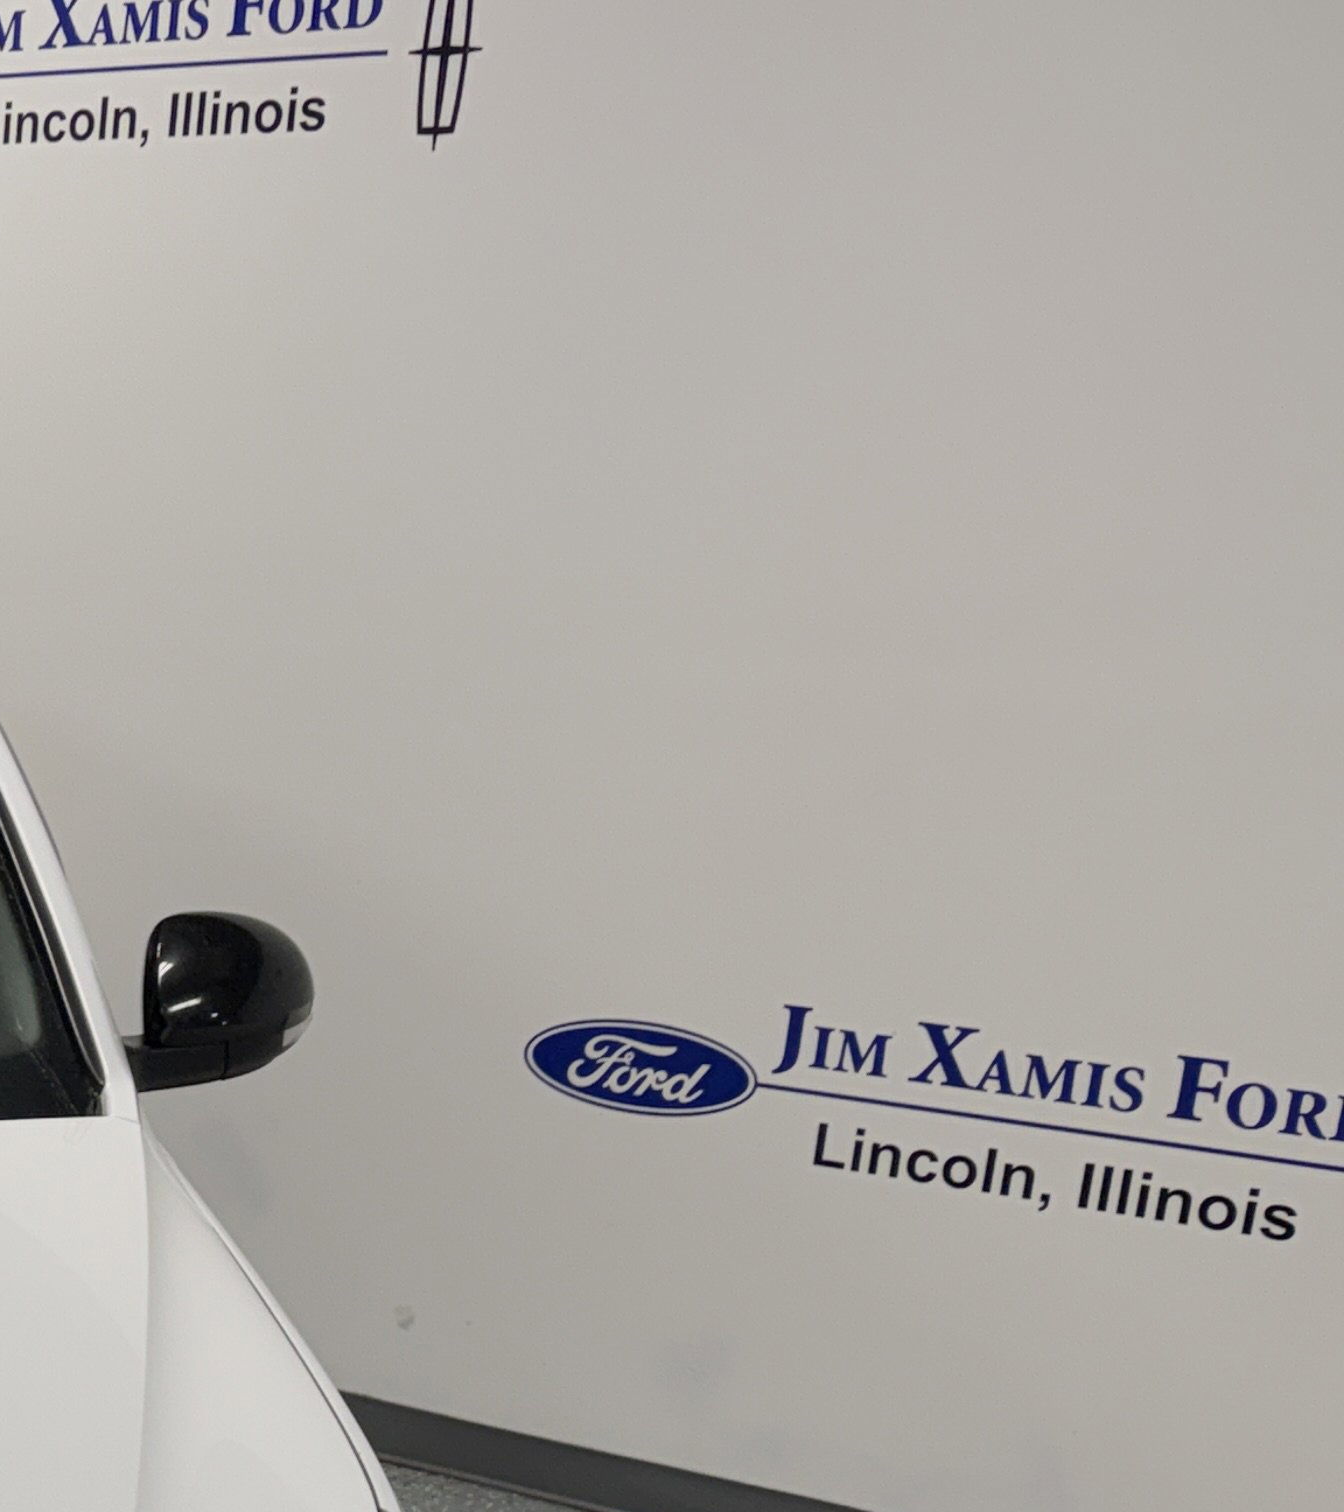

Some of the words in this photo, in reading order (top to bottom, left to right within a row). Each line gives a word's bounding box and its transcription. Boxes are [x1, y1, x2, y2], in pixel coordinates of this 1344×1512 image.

[39, 0, 210, 50] XAMIS
[168, 87, 326, 137] Illinois
[566, 1033, 711, 1104] Ford
[772, 1004, 893, 1078] JIM
[909, 1021, 1145, 1113] XAMIS
[812, 1122, 1052, 1211] Lincoln,
[1077, 1162, 1298, 1240] Illinois
